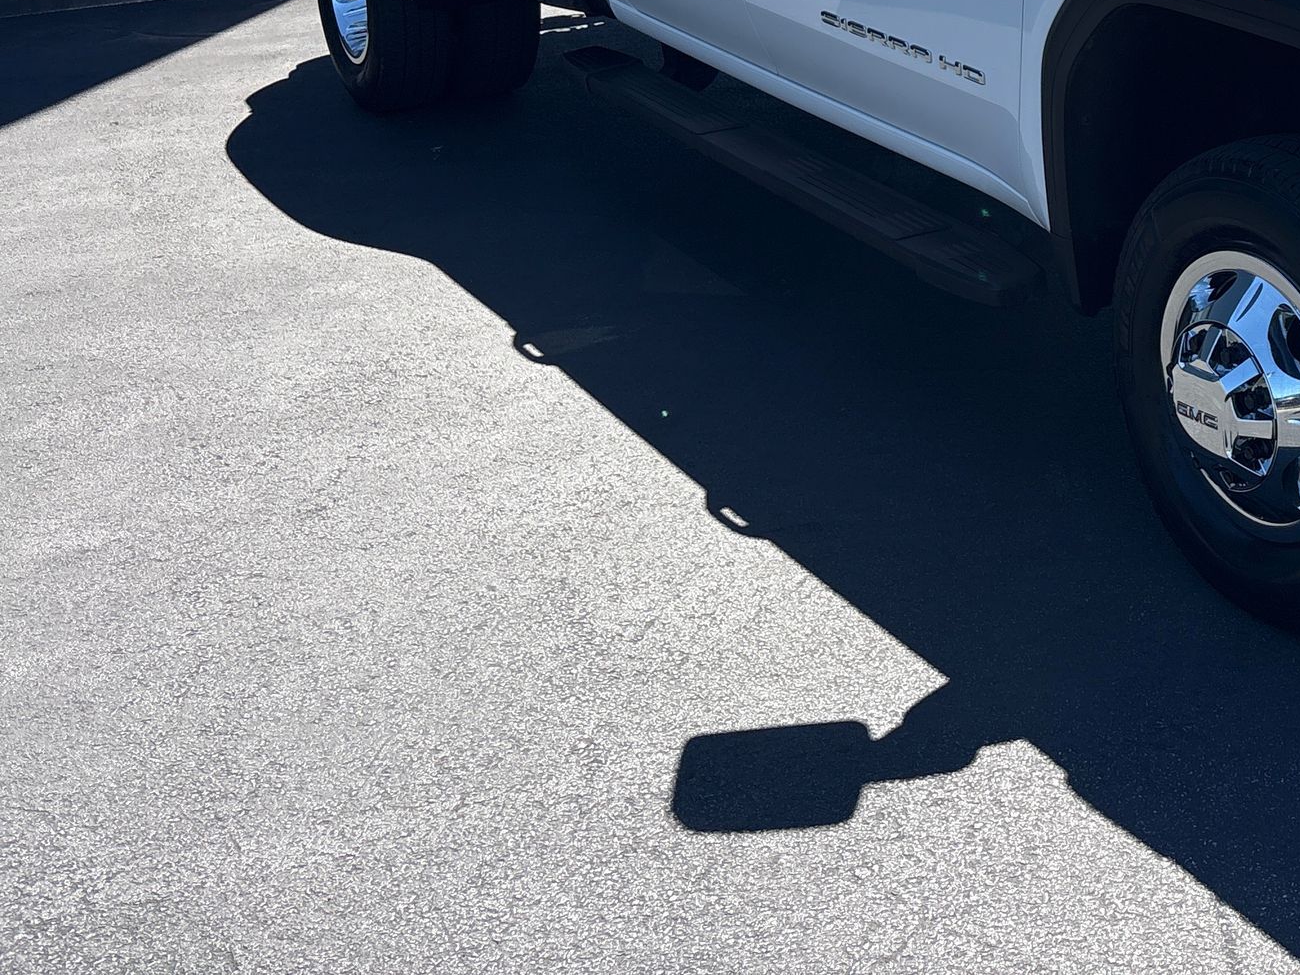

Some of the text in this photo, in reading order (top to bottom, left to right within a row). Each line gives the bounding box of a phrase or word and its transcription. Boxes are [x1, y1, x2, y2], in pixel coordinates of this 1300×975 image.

[820, 10, 986, 86] SIERRA HD
[1176, 400, 1219, 431] GMC
